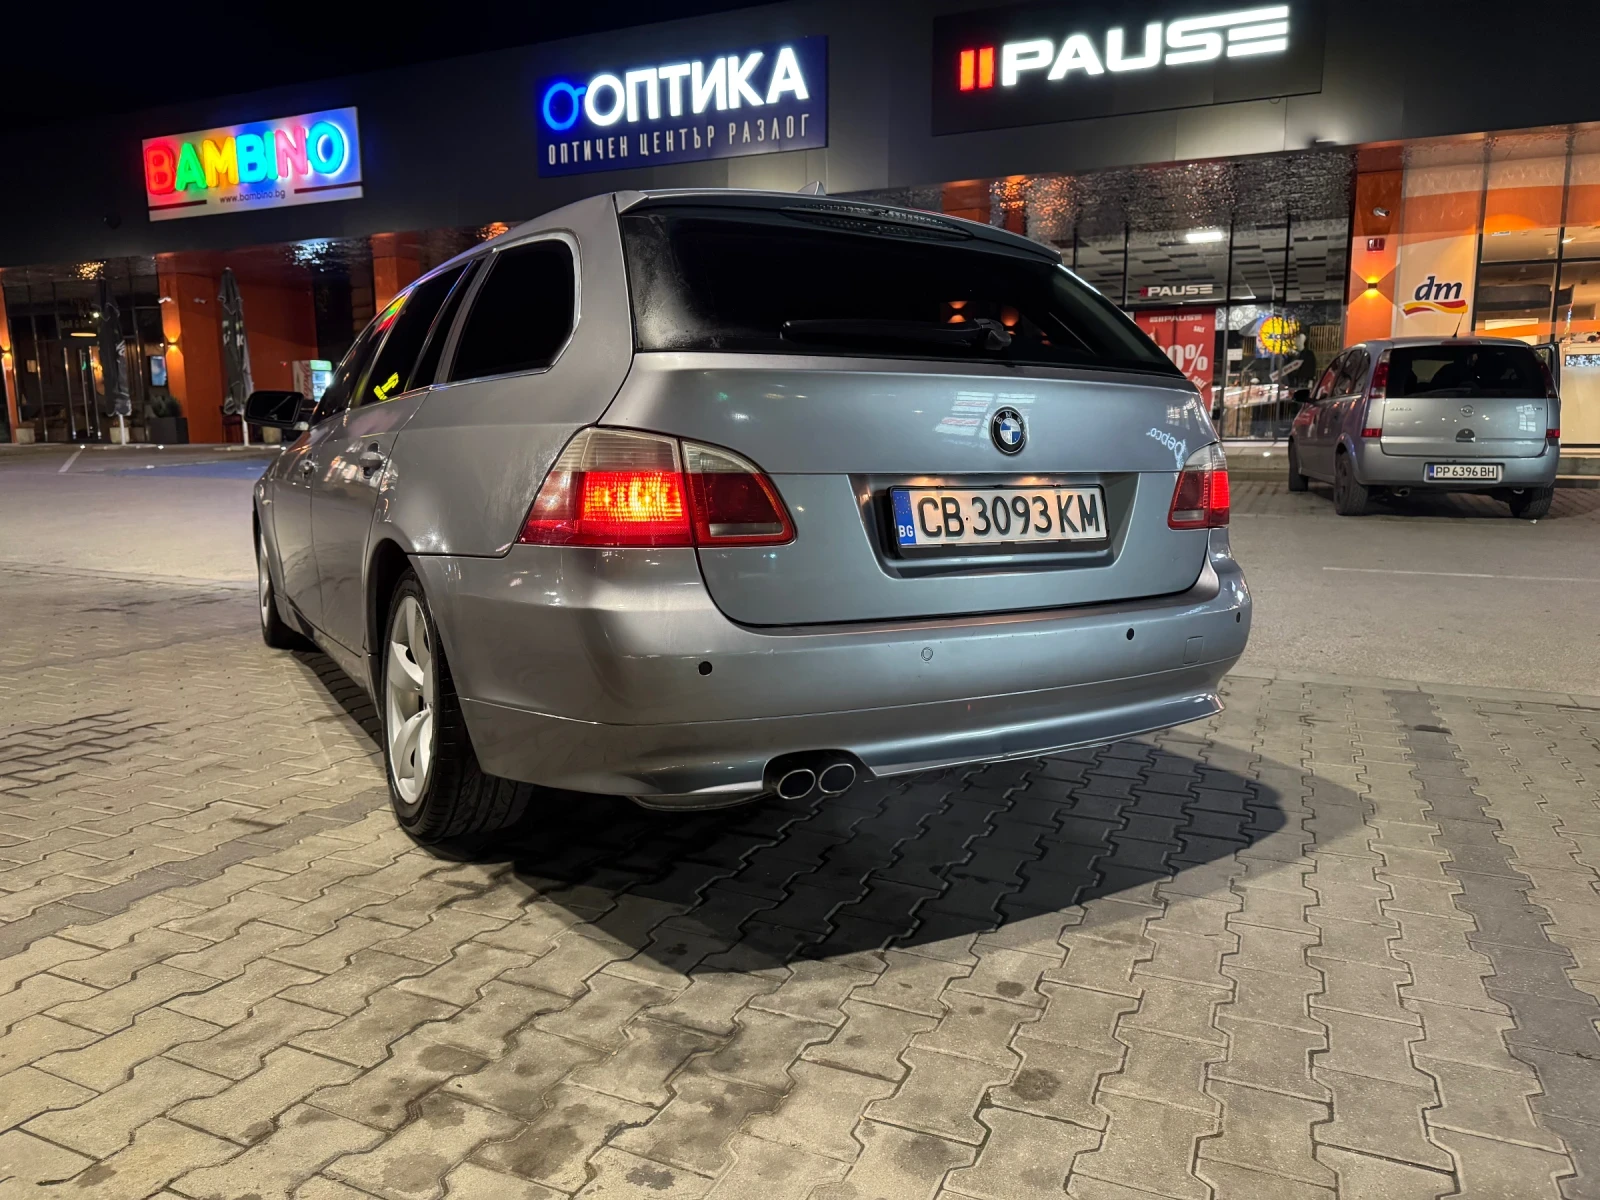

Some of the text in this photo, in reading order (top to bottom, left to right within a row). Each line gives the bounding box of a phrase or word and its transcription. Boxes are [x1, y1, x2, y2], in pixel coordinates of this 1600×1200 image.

[1002, 5, 1288, 86] PAUSE
[584, 46, 809, 126] ОПТИКА
[548, 113, 809, 166] ОПТИЧЕН ЦЕНТЪР РАЗЛОГ
[146, 121, 348, 195] BAMBINO
[219, 188, 286, 204] www.bambino.bg
[1147, 284, 1213, 297] PAUSE
[1414, 276, 1463, 301] dm
[1158, 343, 1208, 372] 0%
[996, 411, 1022, 425] BMW
[1435, 466, 1495, 477] PP 6396 BH
[917, 493, 1101, 538] CB 3093 KM
[899, 524, 914, 538] BG
